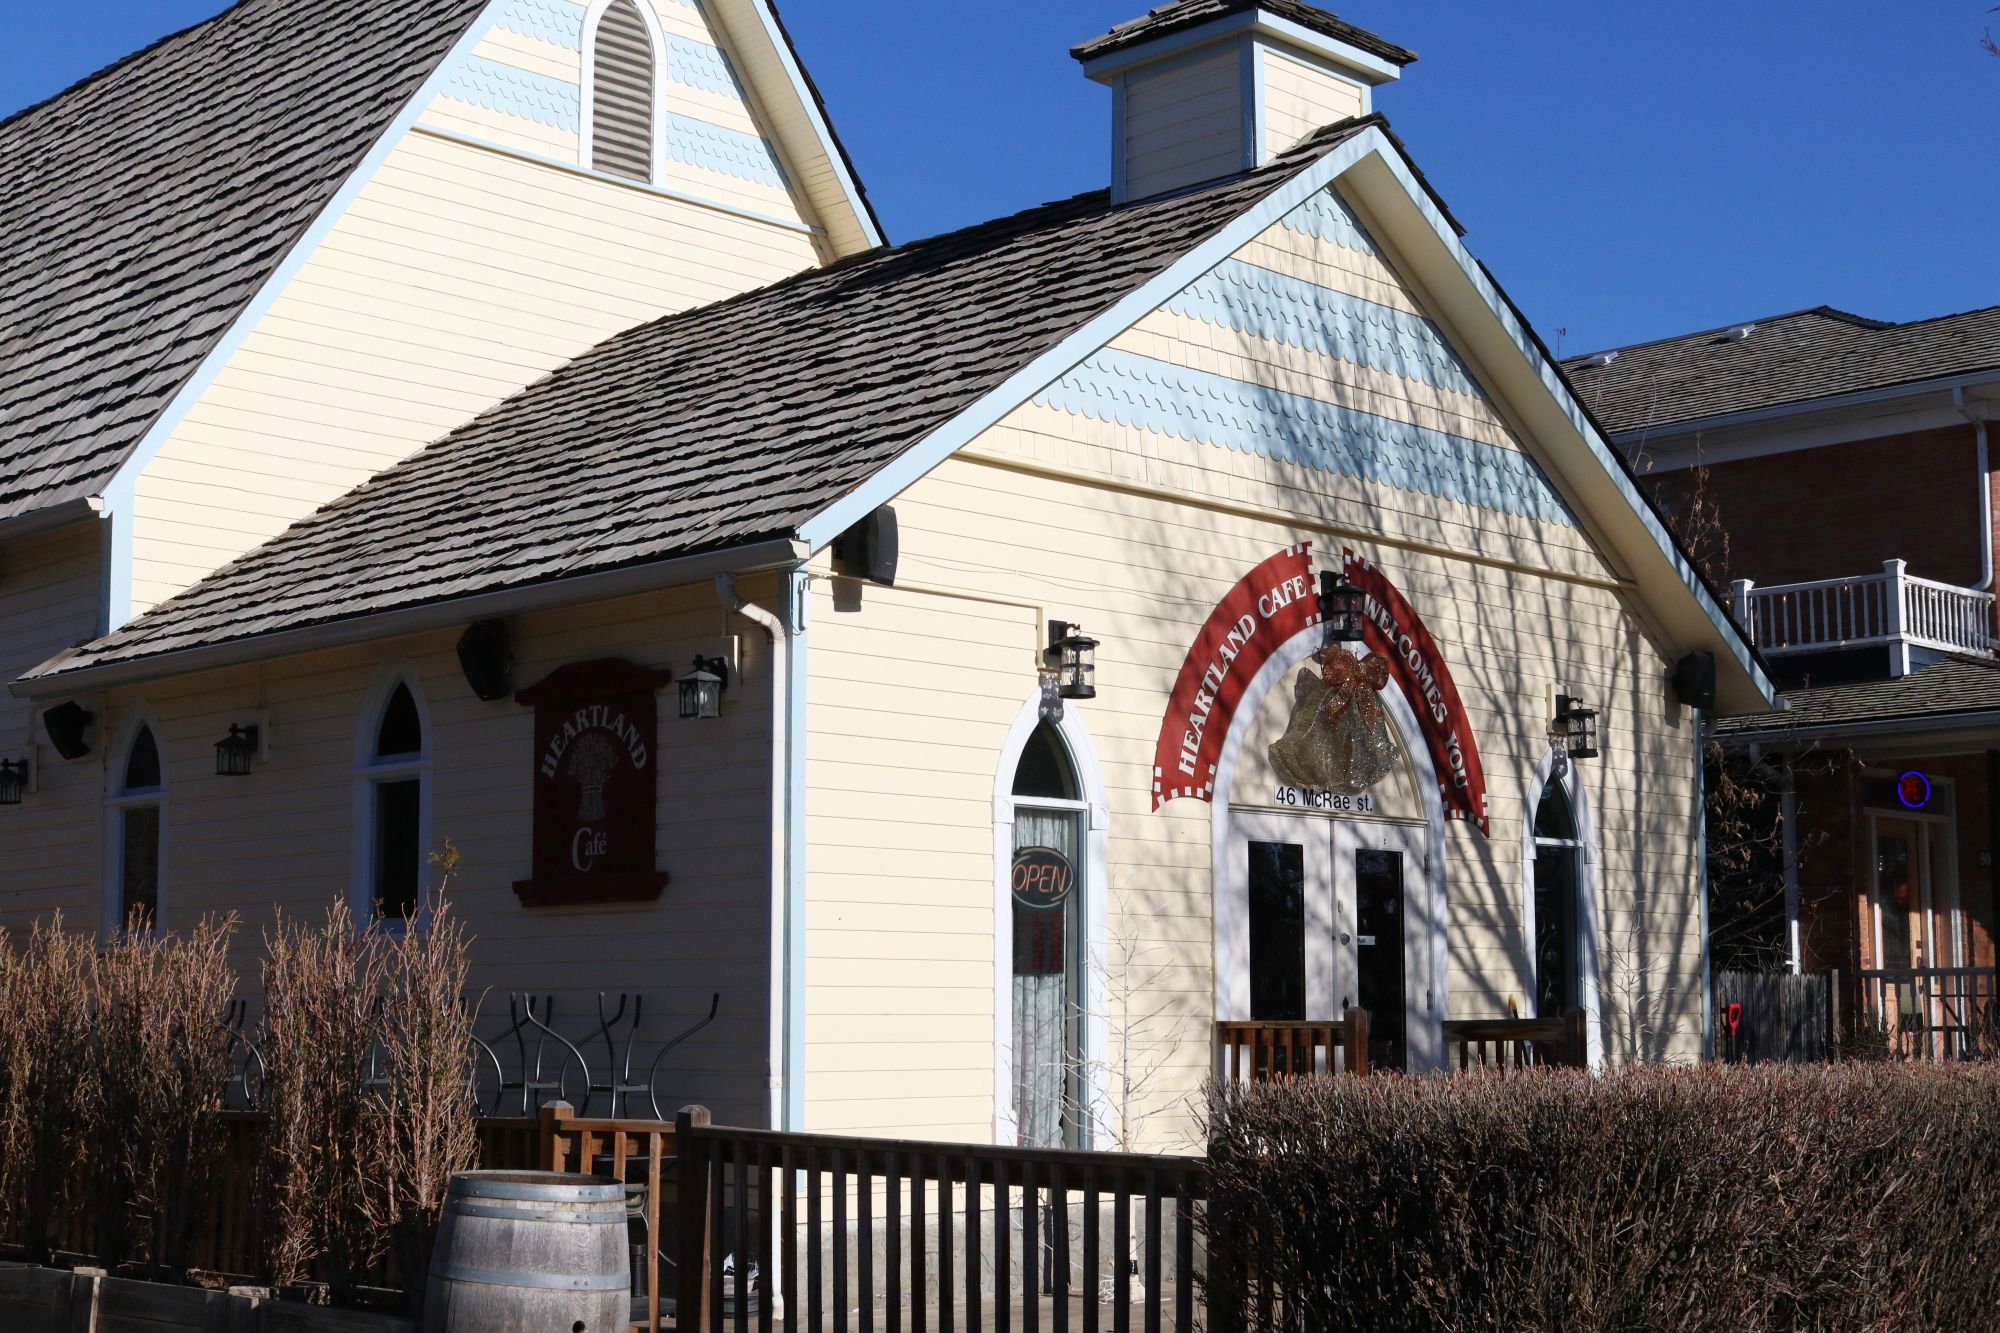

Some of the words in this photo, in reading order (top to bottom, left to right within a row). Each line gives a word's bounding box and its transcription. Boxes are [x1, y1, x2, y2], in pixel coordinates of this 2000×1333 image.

[1178, 613, 1257, 777] HEARTLAND
[1257, 574, 1307, 619] CAFE
[1364, 592, 1448, 725] WELCOMES
[1445, 728, 1469, 789] YOU
[541, 705, 647, 779] HEARTLAND
[1276, 786, 1296, 805] 46
[1302, 788, 1350, 810] McRae
[1357, 794, 1373, 812] st.
[572, 827, 607, 872] Café
[1012, 864, 1067, 893] OPEN
